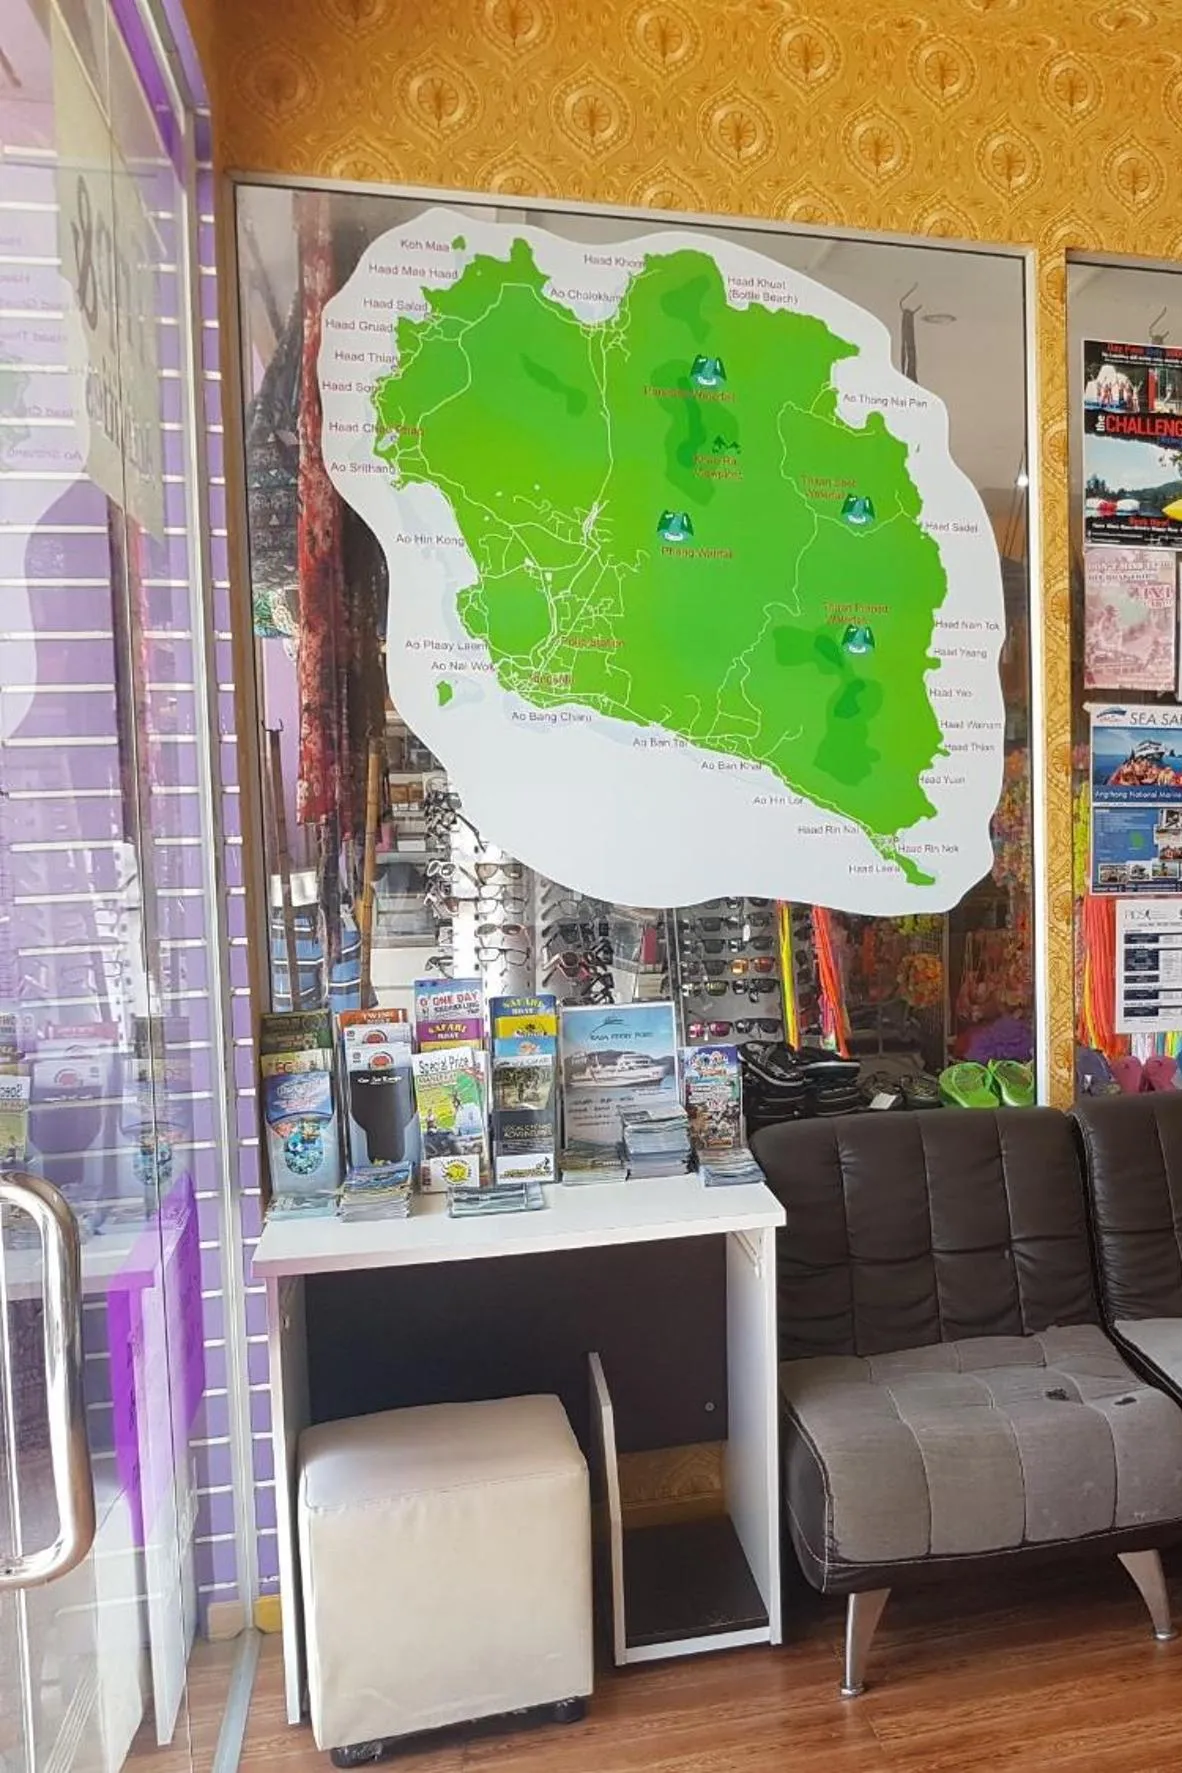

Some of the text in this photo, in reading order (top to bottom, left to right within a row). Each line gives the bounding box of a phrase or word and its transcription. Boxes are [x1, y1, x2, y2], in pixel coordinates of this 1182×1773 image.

[401, 239, 424, 250] Koh
[584, 254, 611, 267] Haad
[369, 263, 399, 276] Haad
[429, 267, 458, 279] Haad
[728, 276, 754, 288] Haad
[551, 288, 567, 299] Ao
[364, 298, 393, 310] Haad
[326, 319, 356, 331] Haad
[335, 352, 364, 362] Haad
[322, 381, 352, 391] Haad
[843, 393, 857, 403] Ao
[329, 422, 359, 432] Haad
[1095, 415, 1105, 432] the
[331, 463, 346, 472] Ao
[926, 522, 950, 533] Haad
[396, 533, 465, 548] Ao Hin Kong
[935, 619, 960, 630] Haad
[985, 621, 1000, 632] Tok
[405, 639, 420, 650] Ao
[431, 661, 447, 671] Ao
[930, 688, 953, 698] Haad
[512, 712, 527, 722] Ao
[529, 712, 557, 724] Bang
[1130, 712, 1156, 725] SEA
[633, 738, 647, 748] Ao
[650, 738, 671, 748] Ban
[944, 743, 968, 752] Haad
[701, 761, 715, 770] Ao
[718, 762, 737, 770] Ban
[918, 776, 941, 785] Haad
[753, 796, 767, 805] Ao
[798, 825, 826, 835] Haad
[828, 825, 842, 835] Rin
[899, 844, 923, 854] Haad
[925, 844, 940, 854] Rin
[849, 864, 874, 874] Haad
[433, 991, 479, 1006] ONE DAY
[418, 1056, 448, 1074] Special
